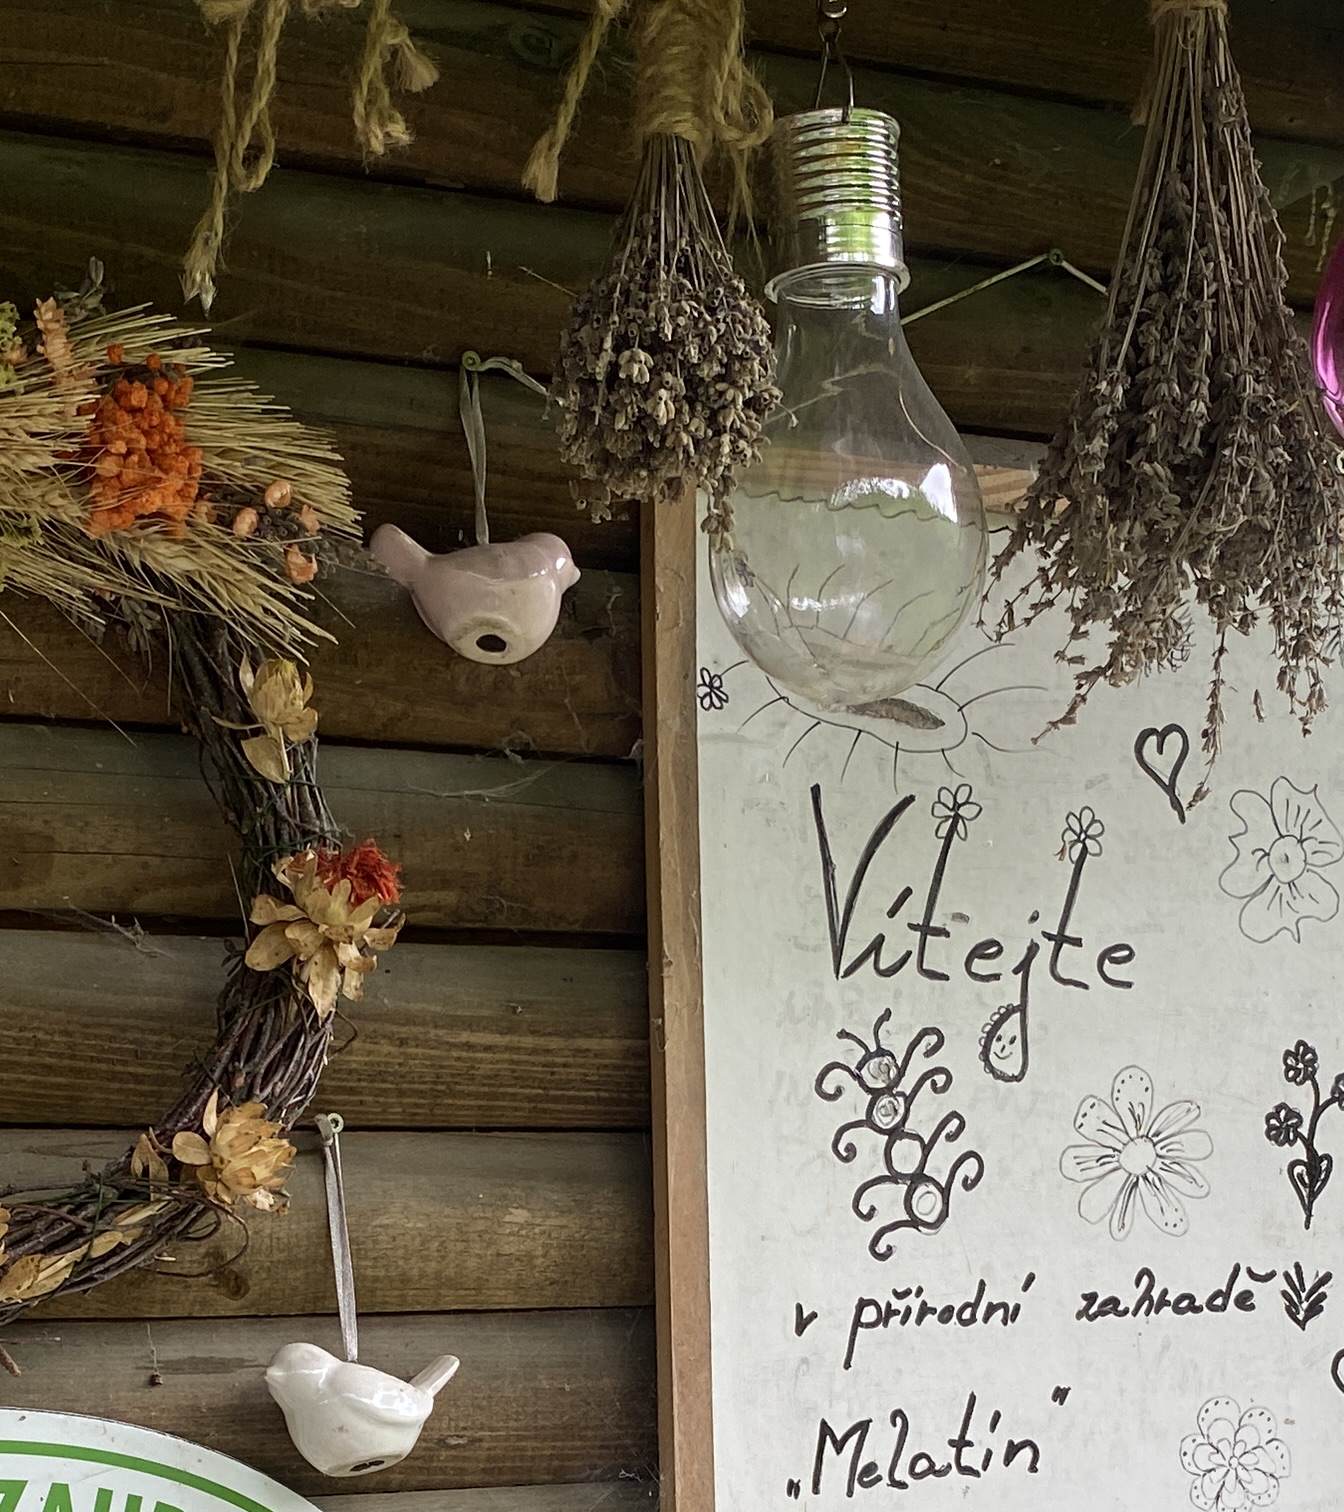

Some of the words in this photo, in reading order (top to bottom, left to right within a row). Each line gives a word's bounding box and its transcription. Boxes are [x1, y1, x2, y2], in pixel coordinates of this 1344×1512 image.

[810, 782, 1136, 1083] Vítejte
[844, 1272, 1037, 1370] přírodní
[1076, 1262, 1277, 1323] zahradě
